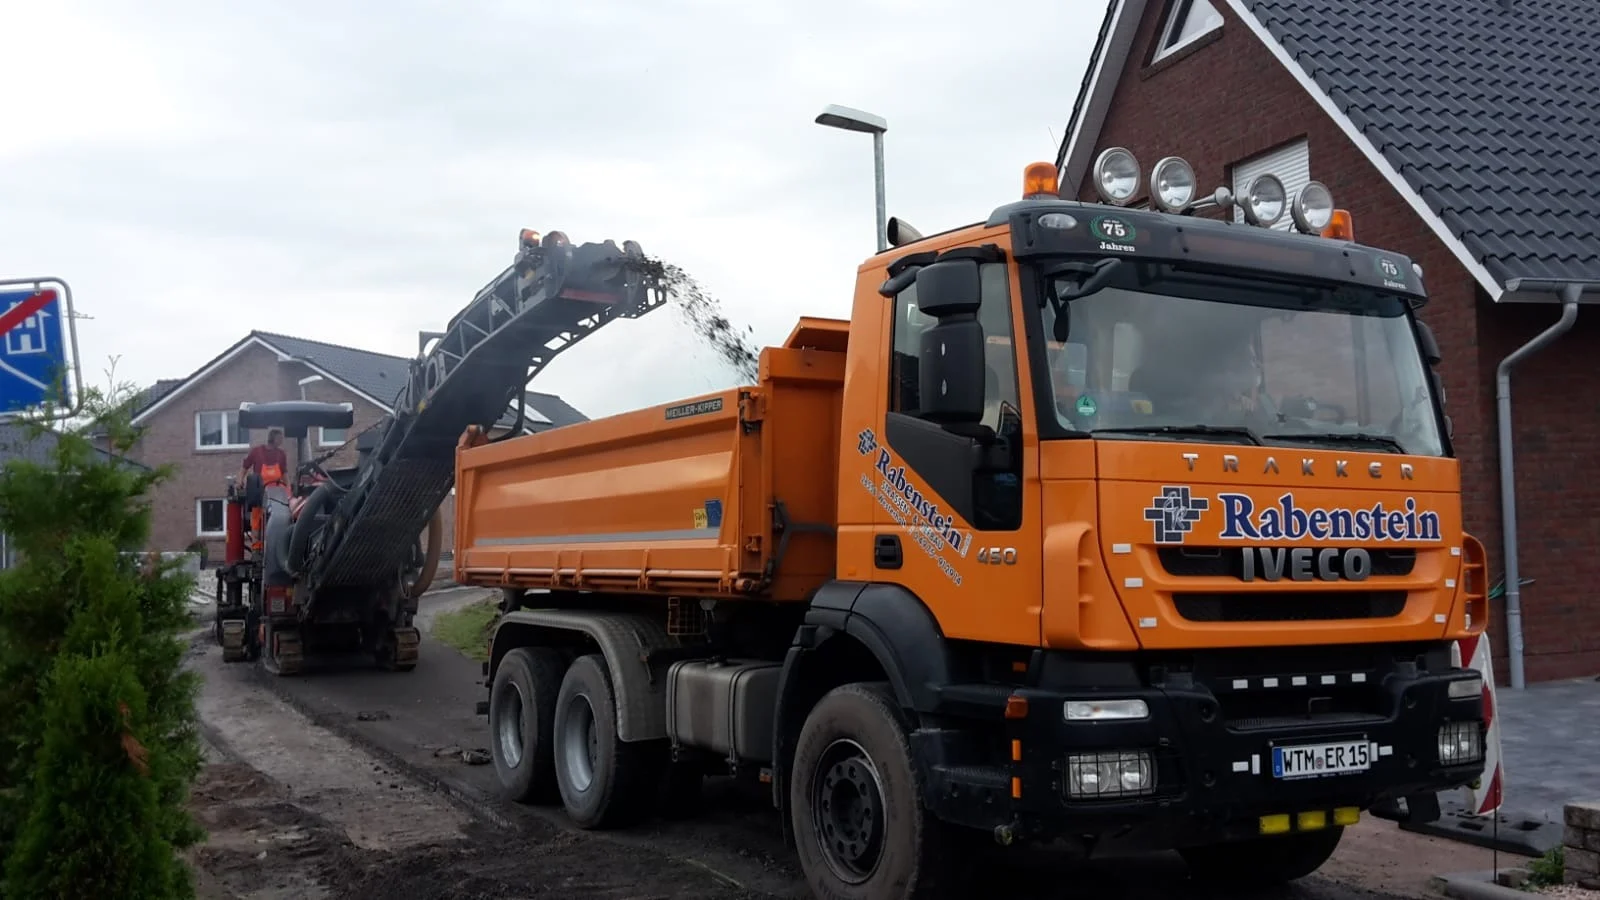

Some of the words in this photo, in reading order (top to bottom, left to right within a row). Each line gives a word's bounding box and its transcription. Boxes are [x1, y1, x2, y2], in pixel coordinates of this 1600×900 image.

[1102, 222, 1126, 237] 75
[1100, 241, 1135, 252] Jahren
[1381, 262, 1397, 275] 75
[1183, 453, 1414, 480] TRAKKER
[876, 447, 962, 551] Rabenstein
[1218, 493, 1441, 541] Rabenstein
[977, 547, 1017, 566] 450
[1242, 547, 1372, 582] IVECO
[1283, 749, 1315, 773] WTM
[1325, 747, 1345, 769] ER
[1349, 745, 1367, 767] 15
